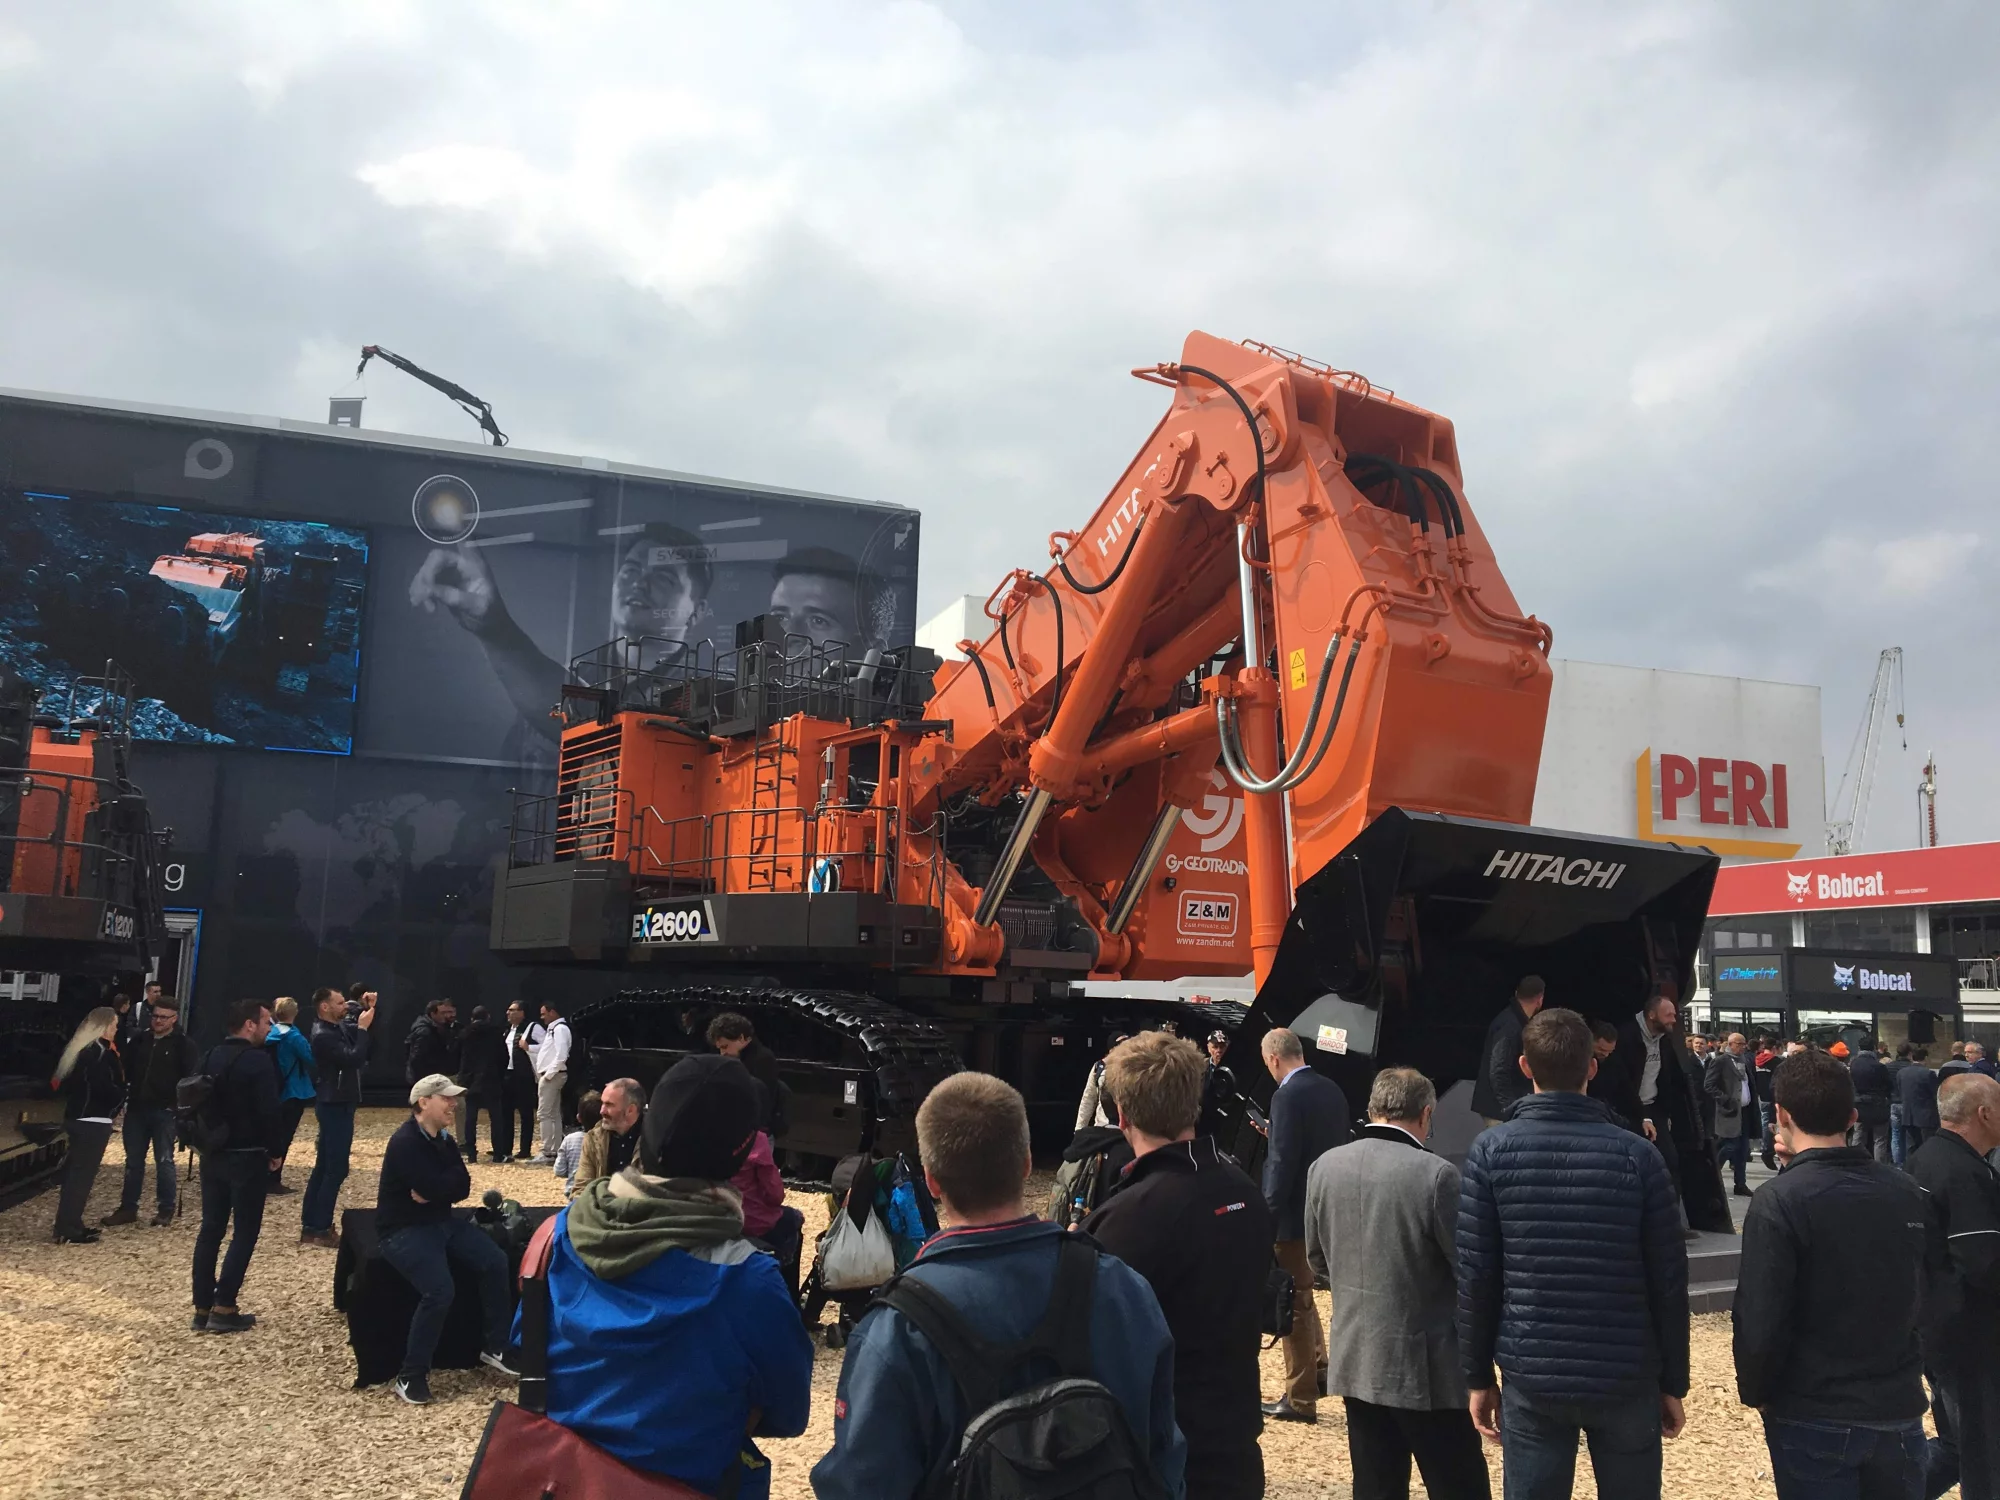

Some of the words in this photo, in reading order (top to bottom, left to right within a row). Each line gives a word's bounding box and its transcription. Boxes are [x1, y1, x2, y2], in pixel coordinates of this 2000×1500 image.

[1097, 453, 1161, 556] HITA
[656, 547, 718, 562] SYSTEM
[1660, 753, 1789, 829] PERI
[1483, 849, 1627, 890] HITACHI
[1817, 871, 1885, 900] Bobcat
[632, 907, 702, 938] EX2600
[1188, 903, 1230, 919] Z&M
[1859, 968, 1913, 992] Bobcat
[1318, 1039, 1345, 1050] HARDOX
